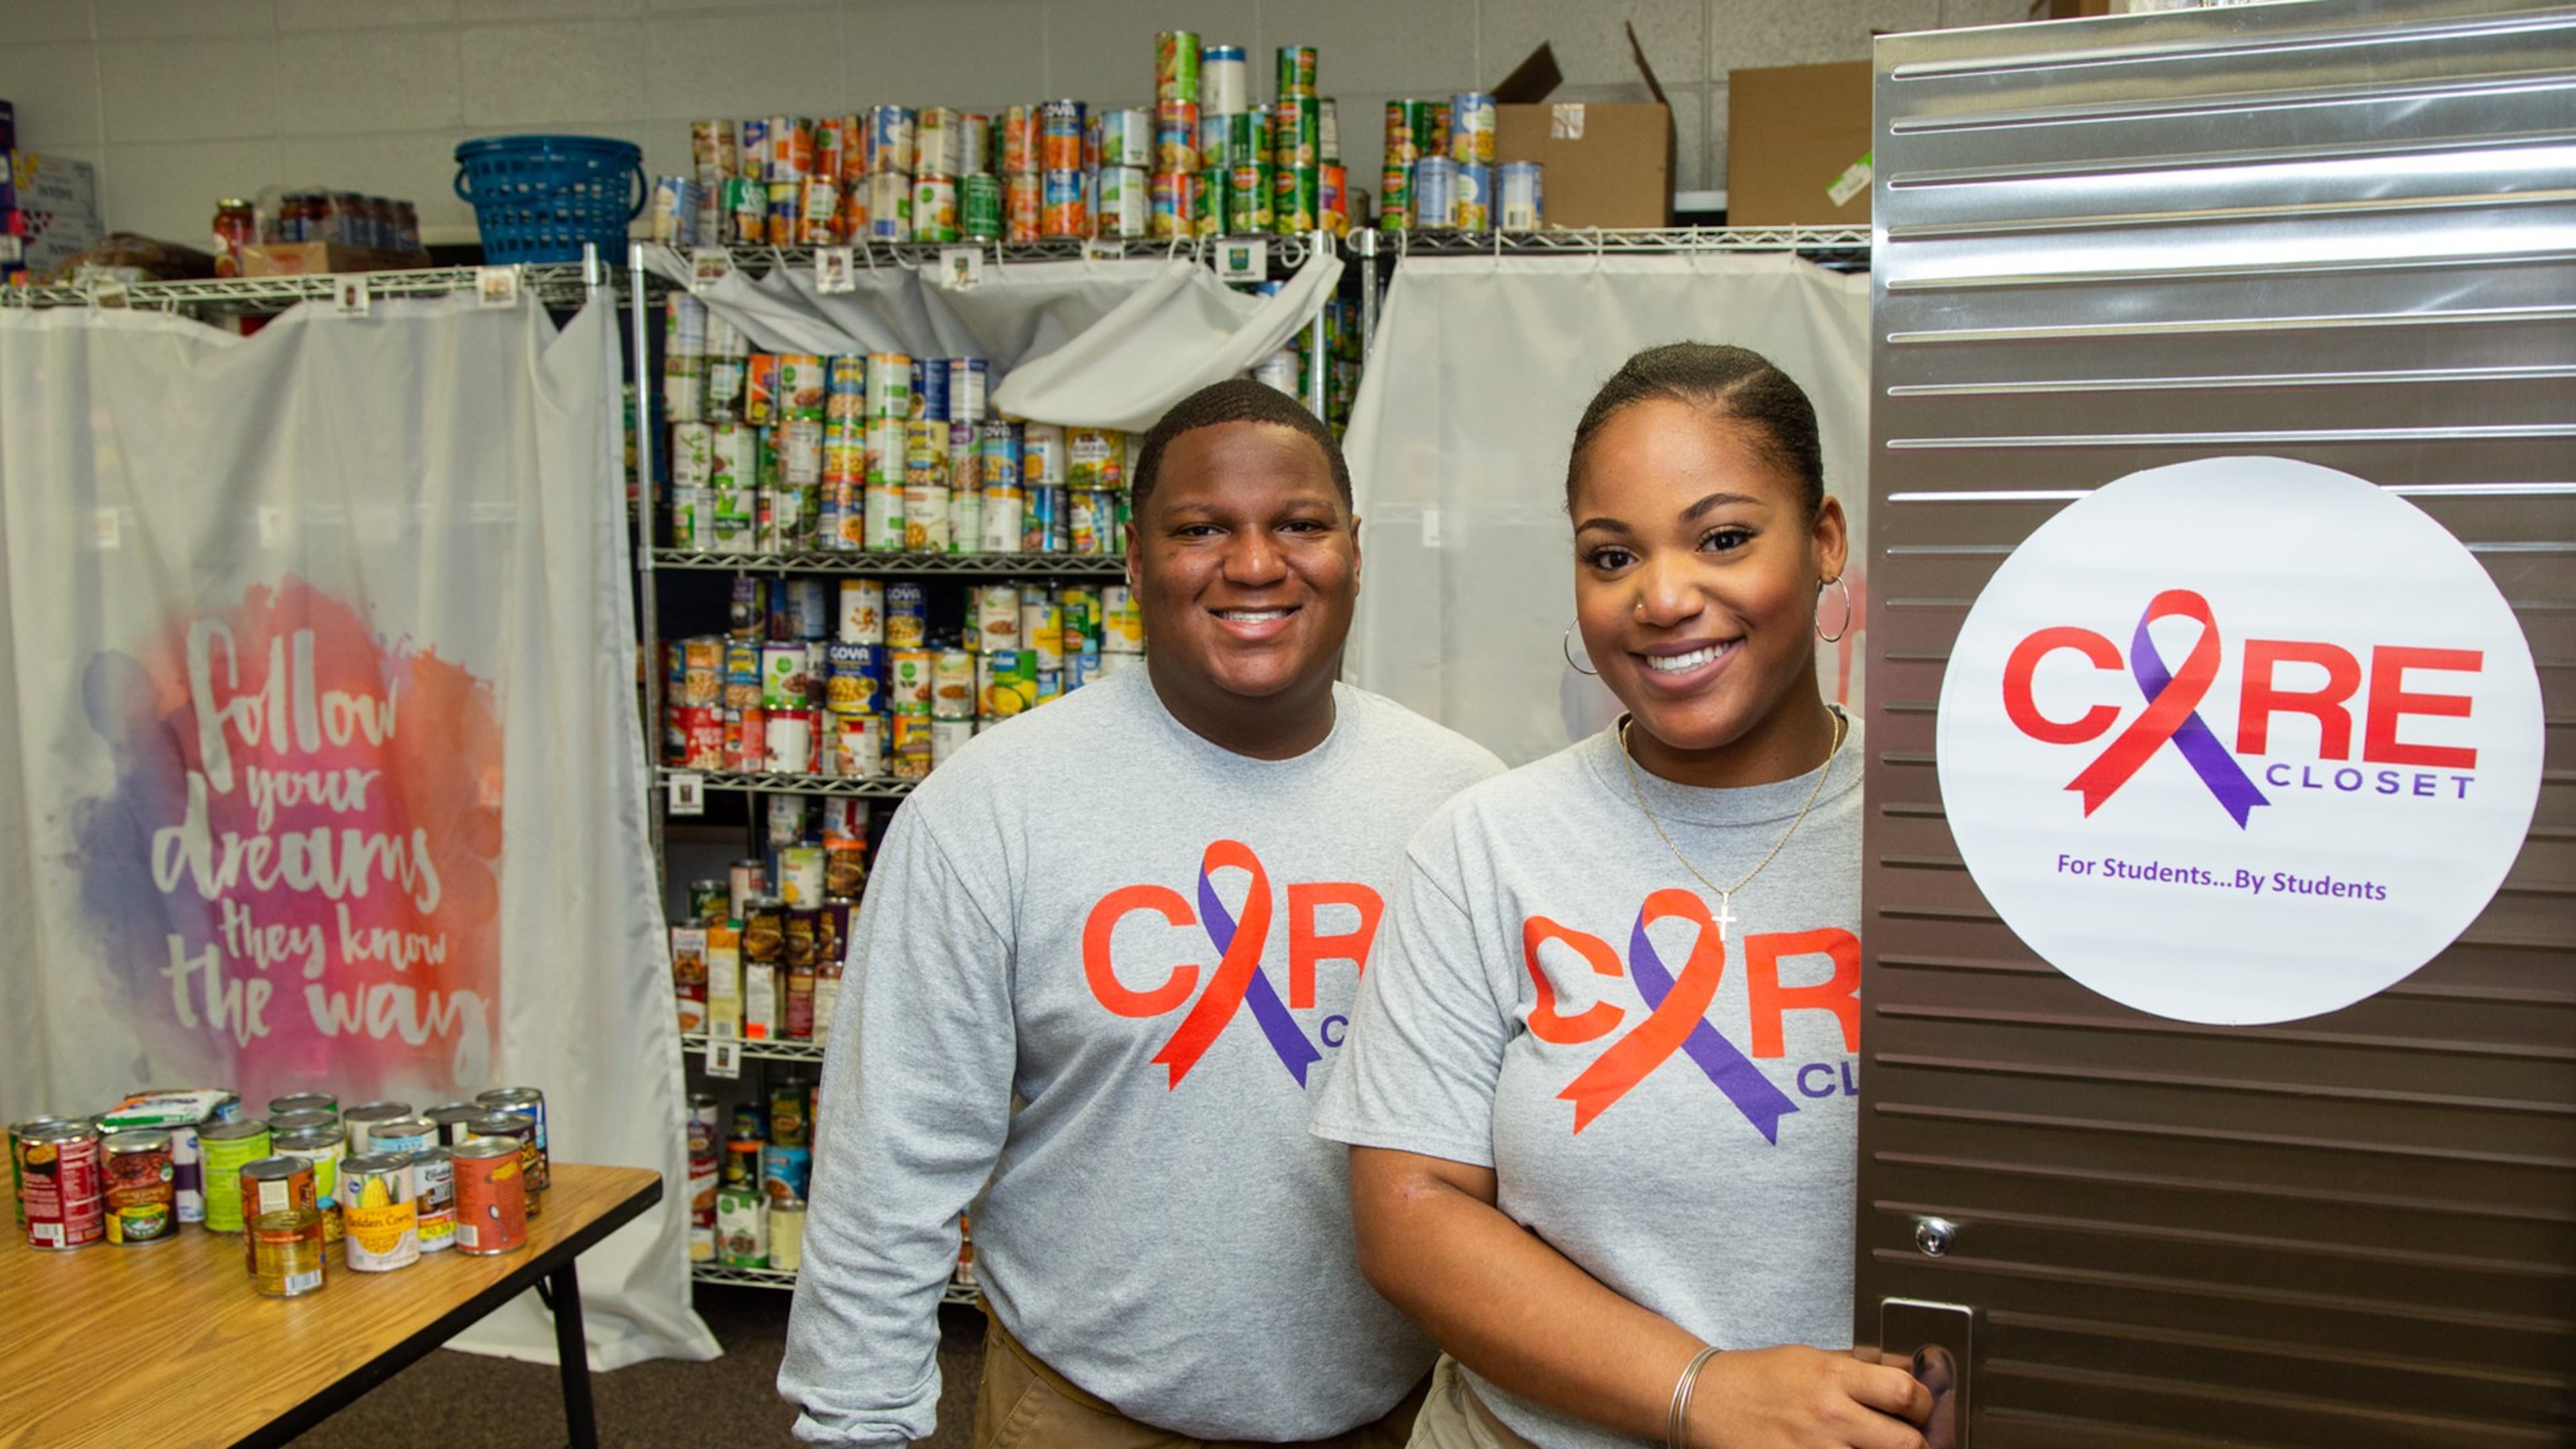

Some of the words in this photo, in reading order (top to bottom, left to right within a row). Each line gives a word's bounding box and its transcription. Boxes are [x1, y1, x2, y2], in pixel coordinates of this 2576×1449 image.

[186, 618, 398, 794] follow
[829, 645, 869, 661] GOYA
[2002, 590, 2483, 829] CARE
[246, 765, 382, 832] your
[2265, 762, 2476, 799] CLOSET
[152, 770, 441, 914] dreams
[2057, 854, 2096, 875] For
[2271, 872, 2387, 901] Students
[218, 898, 326, 978] they
[337, 902, 446, 971] know
[1083, 840, 1384, 1091] CAR
[160, 933, 272, 1048] the
[303, 981, 490, 1086] way
[1523, 889, 1861, 1145] CAR
[347, 1214, 383, 1228] Golden
[386, 1213, 413, 1226] Corn
